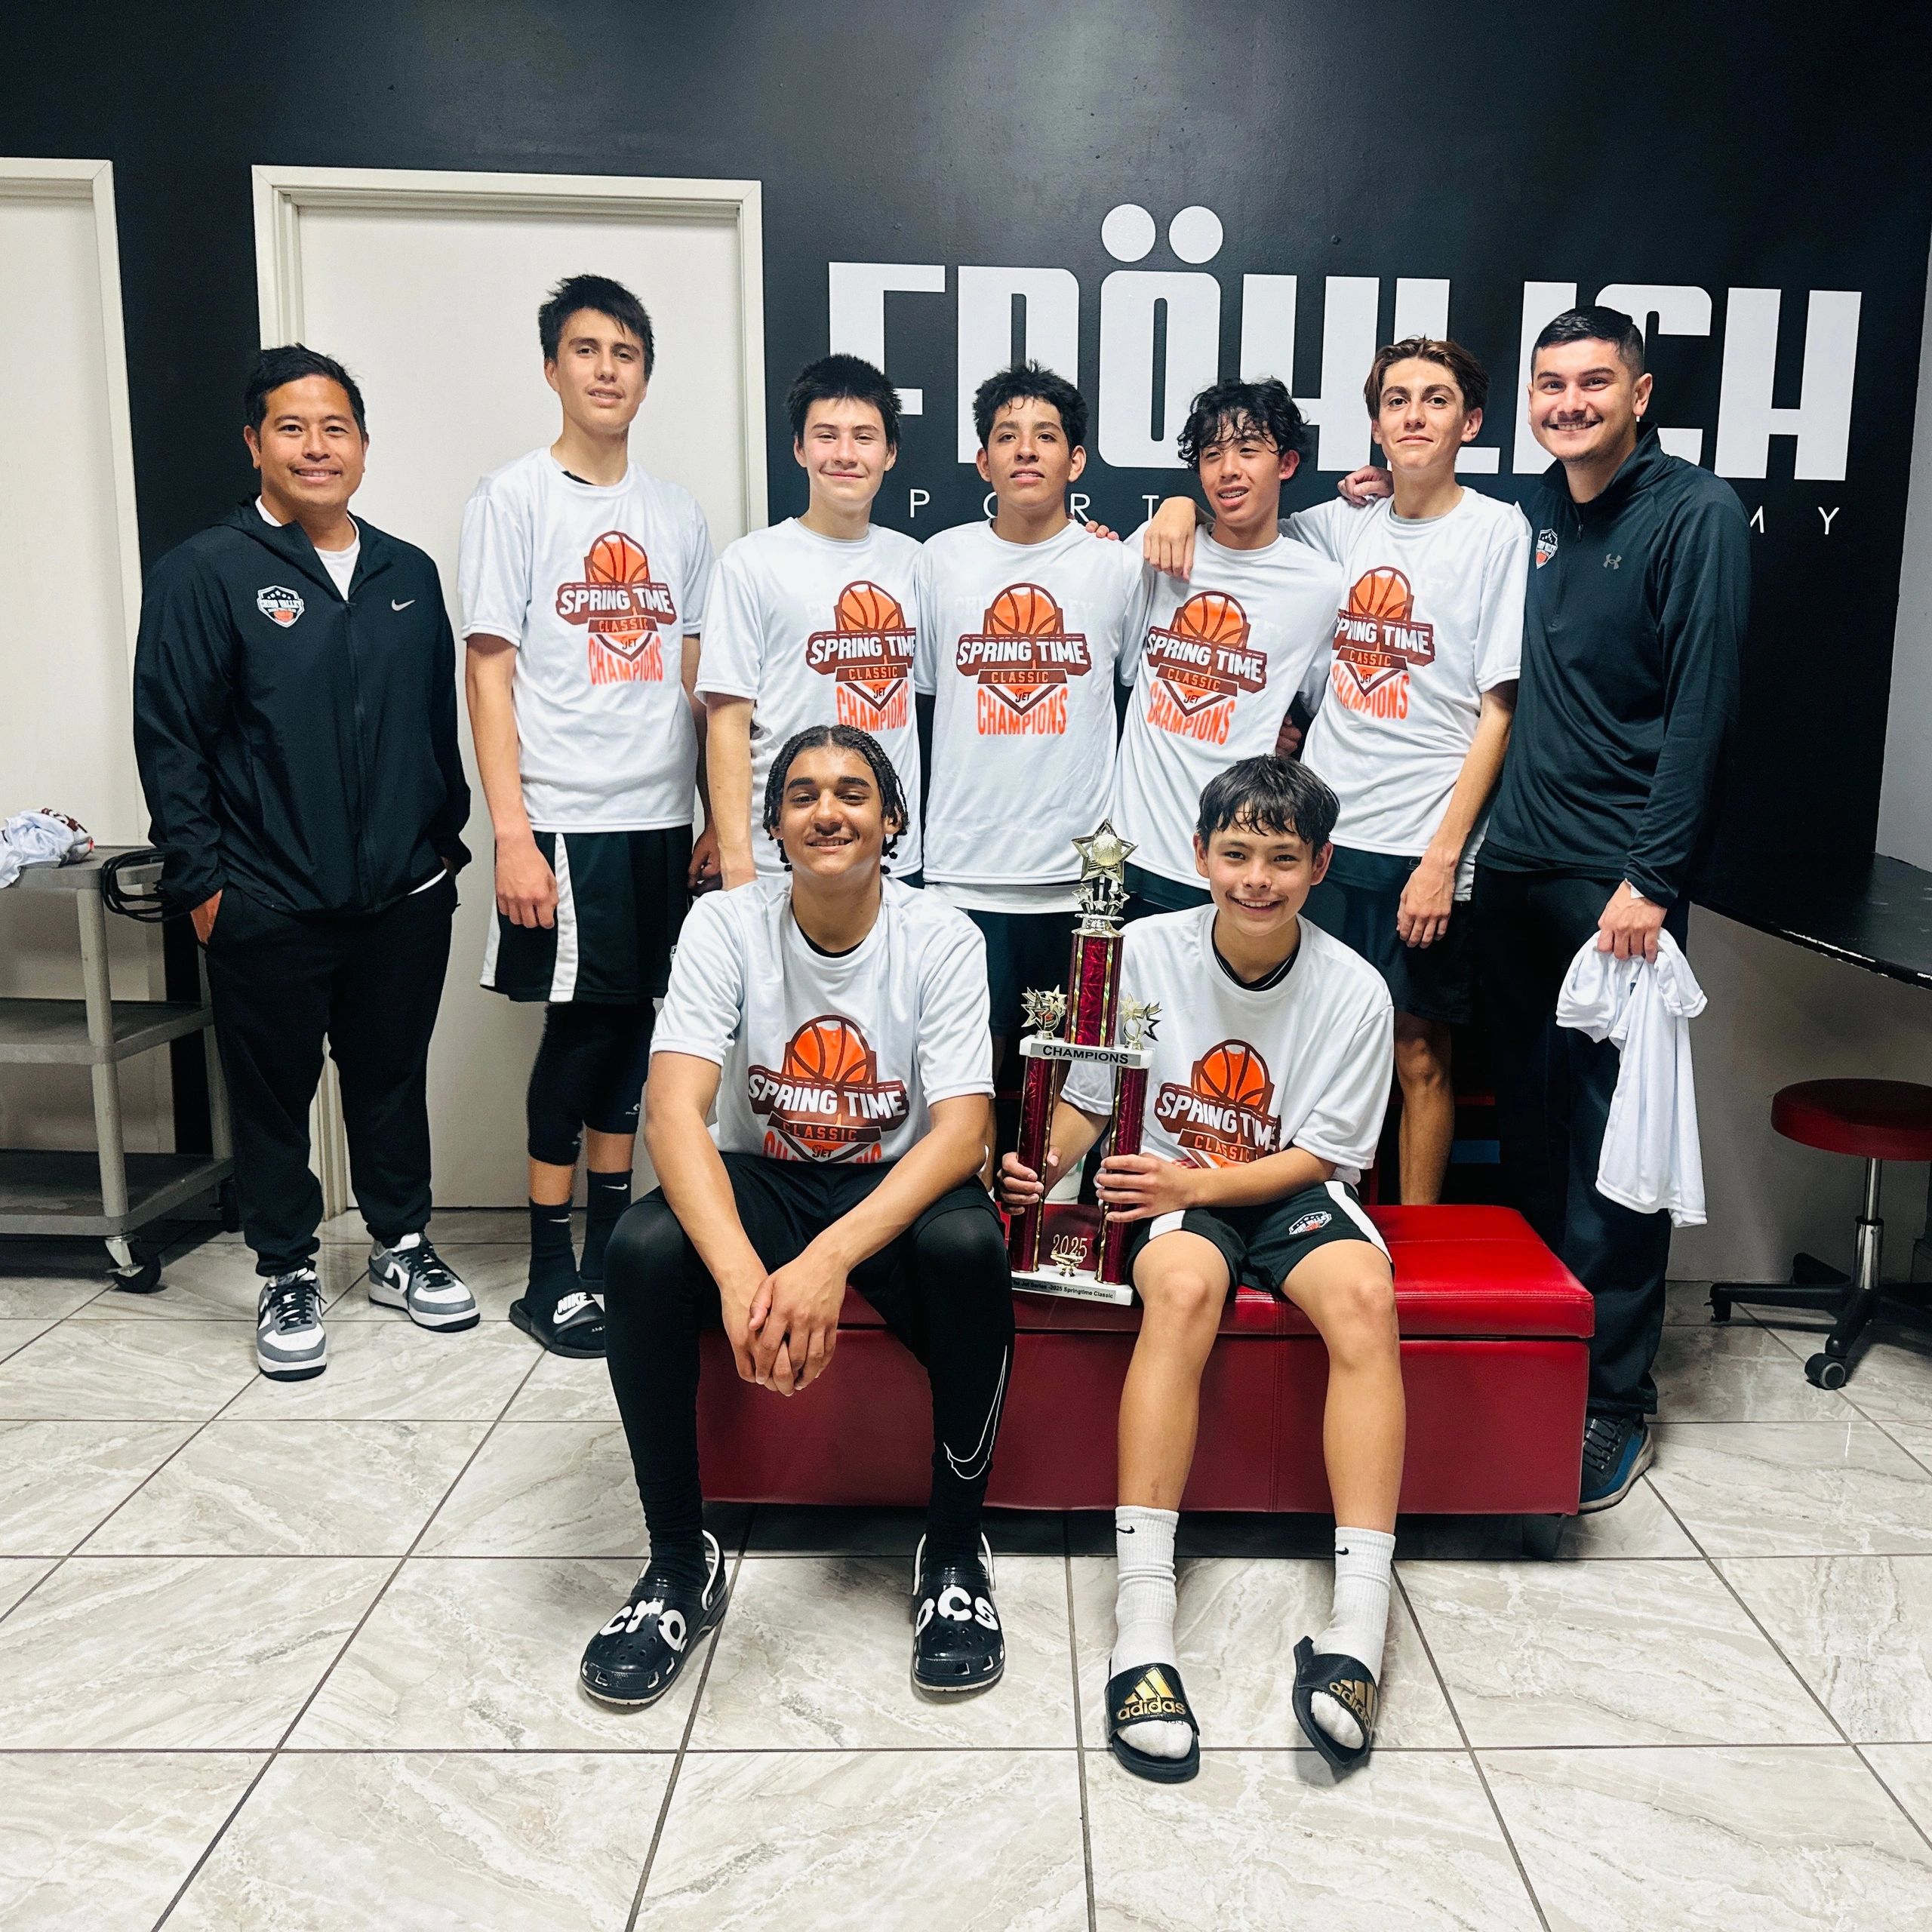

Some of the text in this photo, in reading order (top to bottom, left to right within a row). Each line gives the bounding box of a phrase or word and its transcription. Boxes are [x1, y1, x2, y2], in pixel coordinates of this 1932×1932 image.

[559, 587, 675, 615] SPRING TIME
[598, 619, 648, 632] CLASSIC
[809, 636, 883, 665] SPRING
[1382, 624, 1432, 656] TIME
[588, 635, 664, 686] CHAMPIONS
[957, 641, 1088, 666] SPRING TIME
[1146, 633, 1263, 683] SPRING TIME
[1349, 650, 1392, 667] CASSIC
[848, 666, 898, 680] CLASSIC
[991, 672, 1049, 683] CLASSIC
[1167, 668, 1221, 692] CLASSIC
[1015, 691, 1032, 703] JET
[1183, 694, 1201, 704] JET
[1332, 663, 1411, 720] CHAMPIONS
[835, 680, 909, 732] CHAMPIONS
[977, 688, 1069, 735] CHAMPIONS
[1146, 681, 1236, 745] CHAMPIONS
[1042, 1044, 1129, 1065] CHAMPIONS
[748, 1074, 906, 1119] SPRING TIME
[1157, 1091, 1238, 1134] SPRING
[783, 1121, 858, 1142] CLASSIC
[1194, 1135, 1251, 1163] CLASSIC
[1051, 1234, 1088, 1258] 2025
[557, 1291, 587, 1314] NIKE
[1063, 1287, 1093, 1296] Springtime
[1094, 1291, 1113, 1299] Classic
[1117, 1694, 1187, 1720] adidas
[1329, 1681, 1371, 1732] adida
